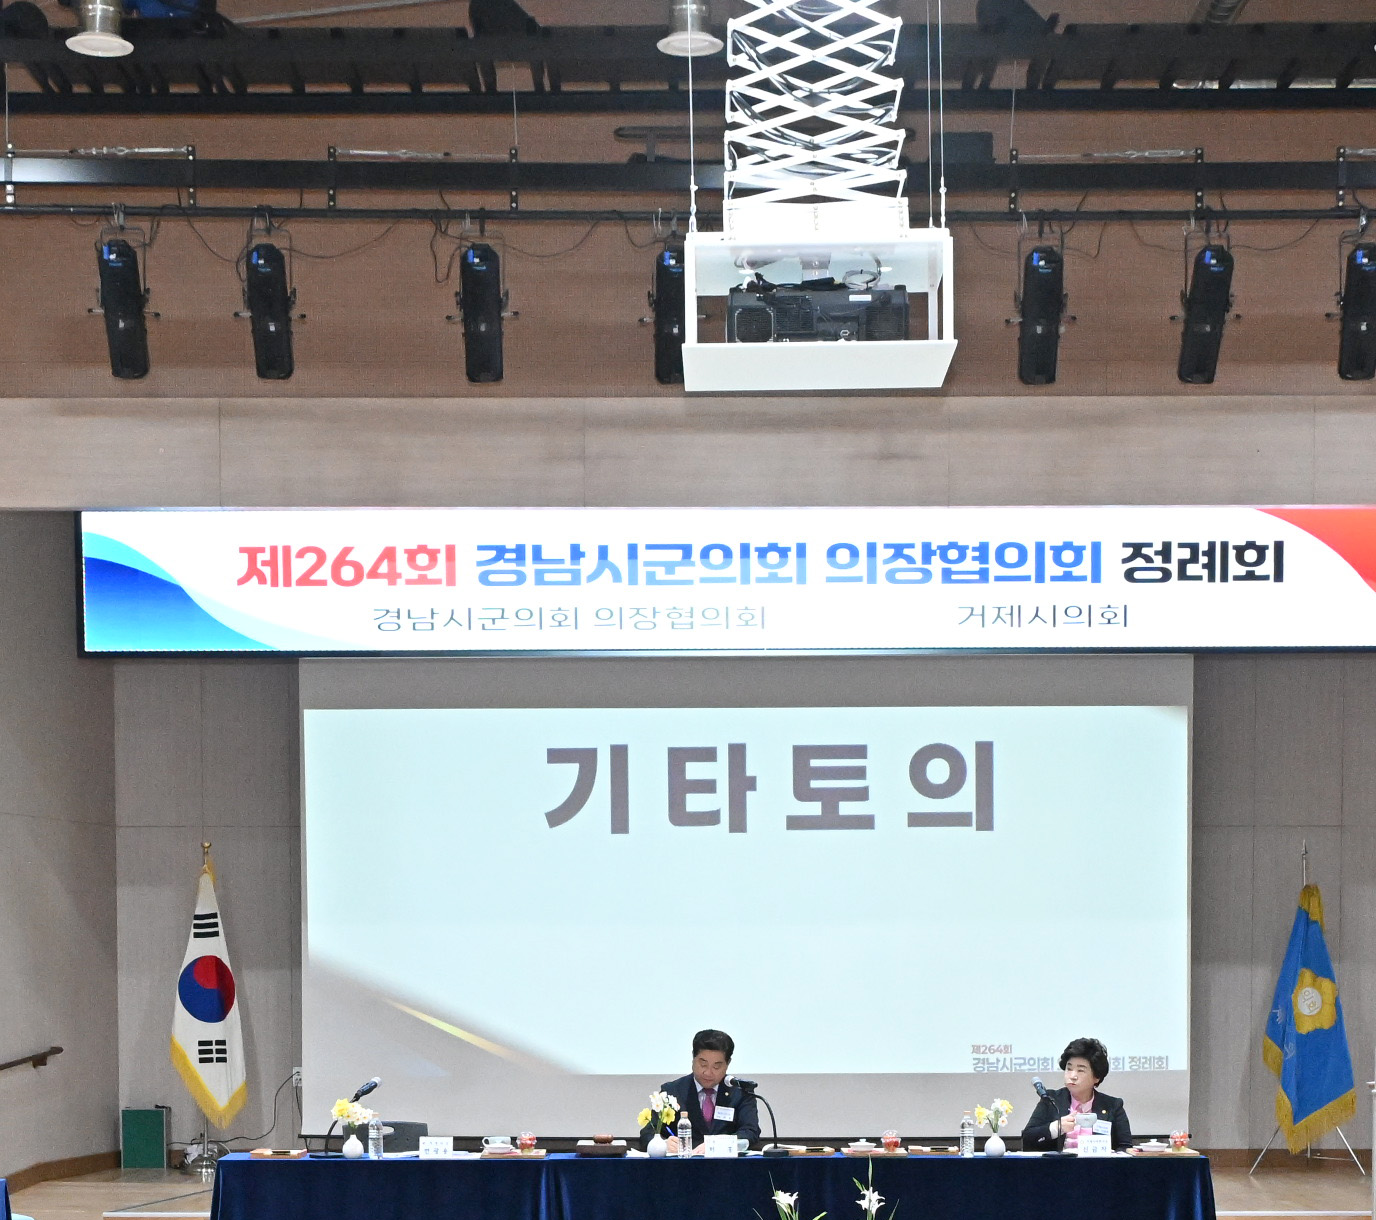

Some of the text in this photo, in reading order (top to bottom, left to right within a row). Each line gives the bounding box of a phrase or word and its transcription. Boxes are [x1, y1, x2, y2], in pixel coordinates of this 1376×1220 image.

[236, 540, 1285, 588] 제264회 경남시군의회 의장협의회 정례회
[372, 605, 766, 632] 경남시군의회 의장협의회
[957, 604, 1129, 629] 거제시의회
[543, 740, 995, 835] 기타토의
[970, 1044, 1013, 1055] 제264회
[972, 1056, 1054, 1073] 경남시군의회
[1128, 1055, 1169, 1071] 정례회
